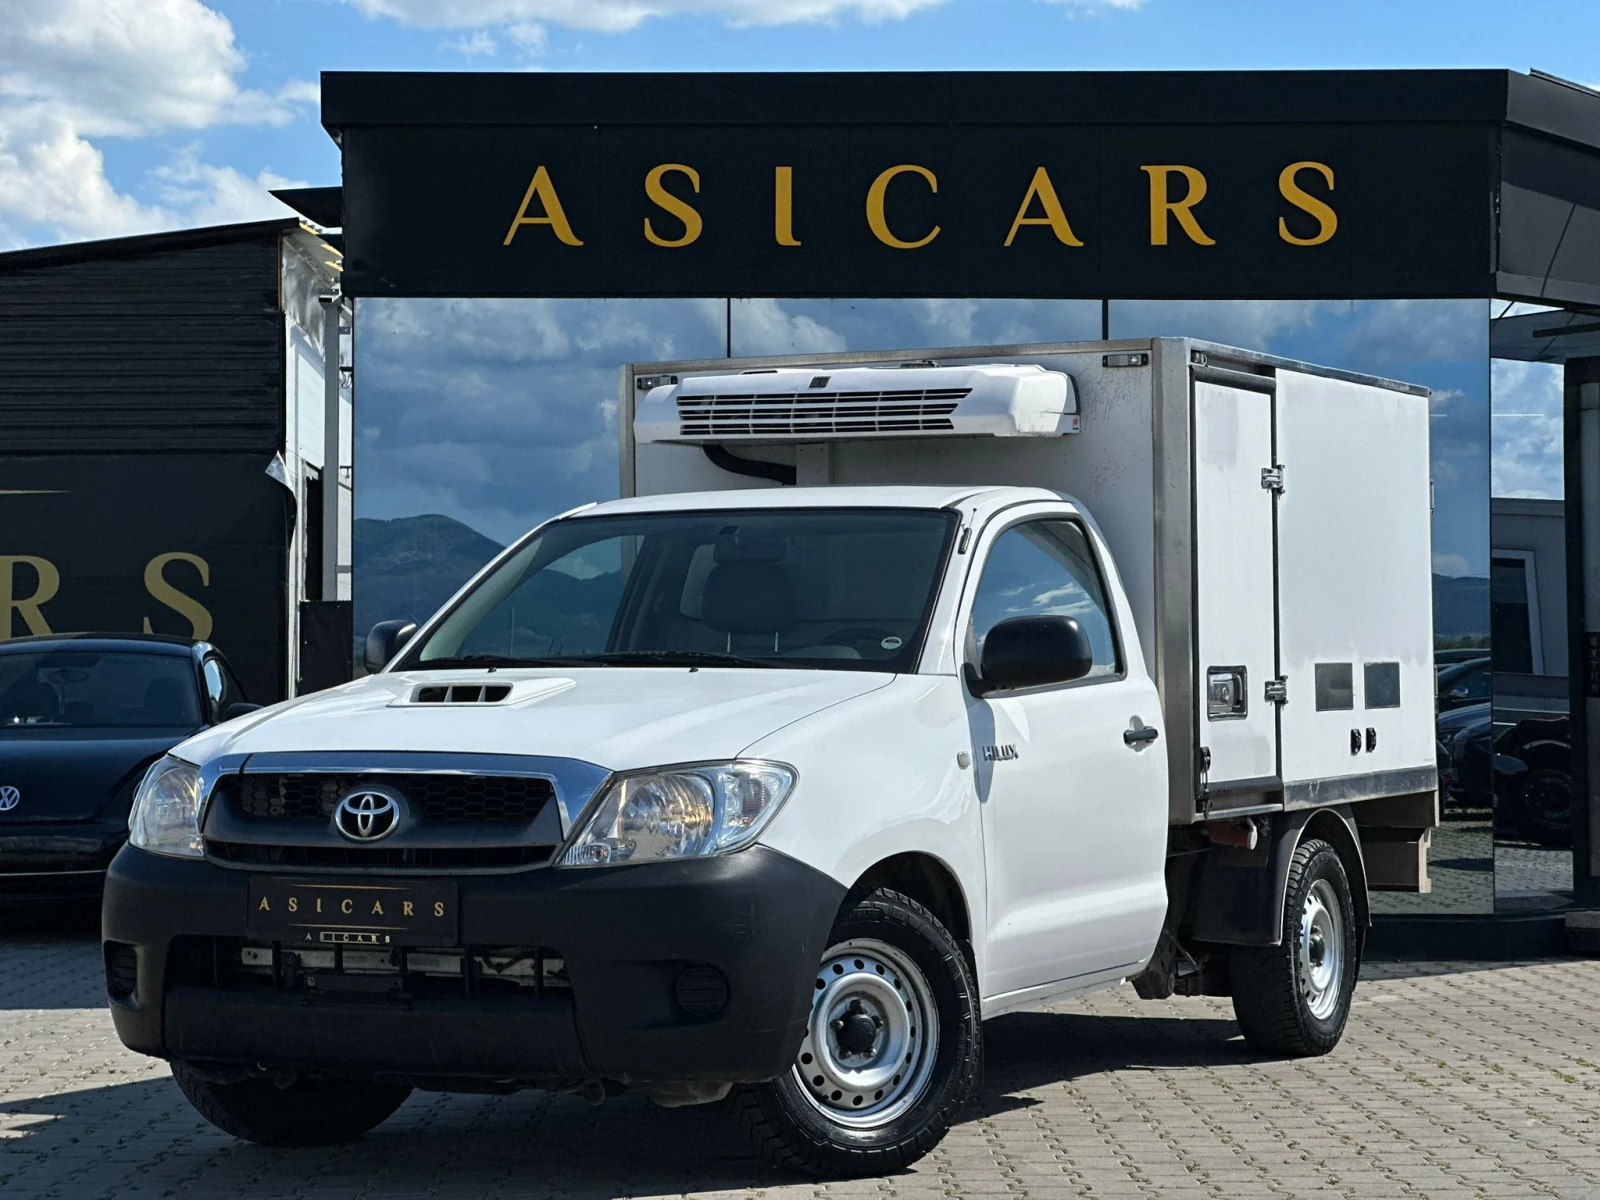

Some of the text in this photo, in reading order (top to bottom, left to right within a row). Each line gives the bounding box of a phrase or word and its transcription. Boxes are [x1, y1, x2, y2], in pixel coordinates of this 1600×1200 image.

[502, 161, 1338, 249] ASICARS
[982, 744, 1019, 761] HILUX
[259, 896, 444, 917] ASICARS
